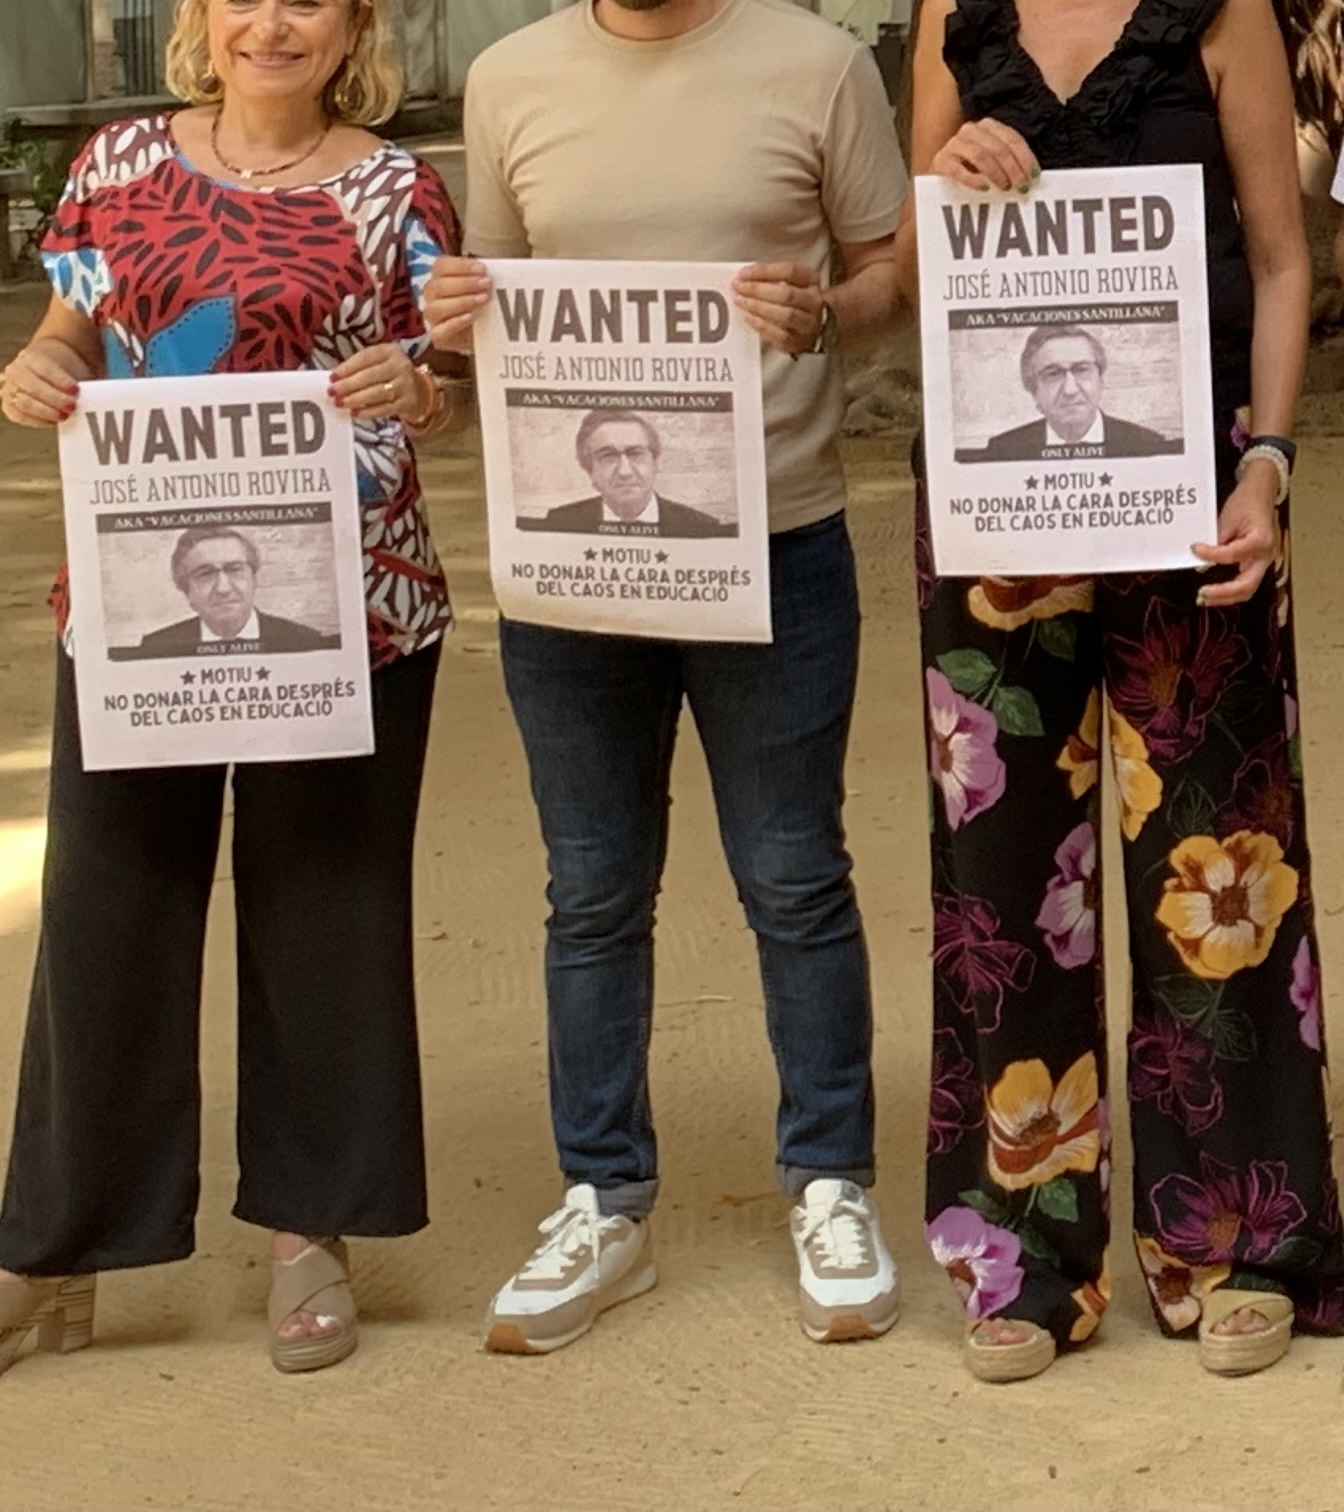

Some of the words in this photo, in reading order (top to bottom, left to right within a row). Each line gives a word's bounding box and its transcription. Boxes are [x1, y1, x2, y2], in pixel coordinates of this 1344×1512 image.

[942, 195, 1175, 261] WANTED
[942, 268, 992, 301] JOSÉ
[998, 268, 1090, 299] ANTONIO
[1096, 264, 1180, 294] ROVIRA
[498, 286, 730, 344] WANTED
[966, 313, 996, 325] AKA
[499, 350, 548, 380] JOSÉ
[554, 356, 645, 382] ANTONIO
[651, 357, 734, 382] ROVIRA
[523, 393, 552, 405] AKA
[87, 399, 326, 466] WANTED
[89, 473, 140, 506] JOSÉ
[147, 471, 241, 503] ANTONIO
[246, 466, 333, 496] ROVIRA
[1043, 471, 1095, 491] MOTIU
[949, 498, 974, 517] NO
[977, 495, 1037, 515] DONAR
[1041, 495, 1062, 512] LA
[1066, 492, 1114, 511] CARA
[1118, 483, 1197, 508] DESPRÉS
[114, 517, 144, 529] AKA
[974, 515, 1005, 533] DEL
[1009, 513, 1057, 532] CAOS
[1061, 512, 1084, 530] EN
[1088, 504, 1174, 529] EDUCACIÓ
[602, 547, 651, 564] MOTIU
[511, 562, 535, 579] NO
[538, 563, 596, 581] DONAR
[600, 567, 620, 582] LA
[624, 567, 671, 584] CARA
[674, 565, 752, 587] DESPRÉS
[535, 580, 567, 597] DEL
[570, 581, 615, 599] CAOS
[619, 583, 642, 600] EN
[645, 584, 729, 603] EDUCACIÓ
[200, 666, 252, 685] MOTIU
[104, 694, 129, 711] NO
[133, 690, 194, 710] DONAR
[198, 689, 220, 705] LA
[224, 685, 273, 704] CARA
[276, 676, 356, 701] DESPRÉS
[130, 710, 162, 727] DEL
[166, 706, 215, 725] CAOS
[219, 705, 243, 722] EN
[246, 696, 333, 720] EDUCACIÓ
